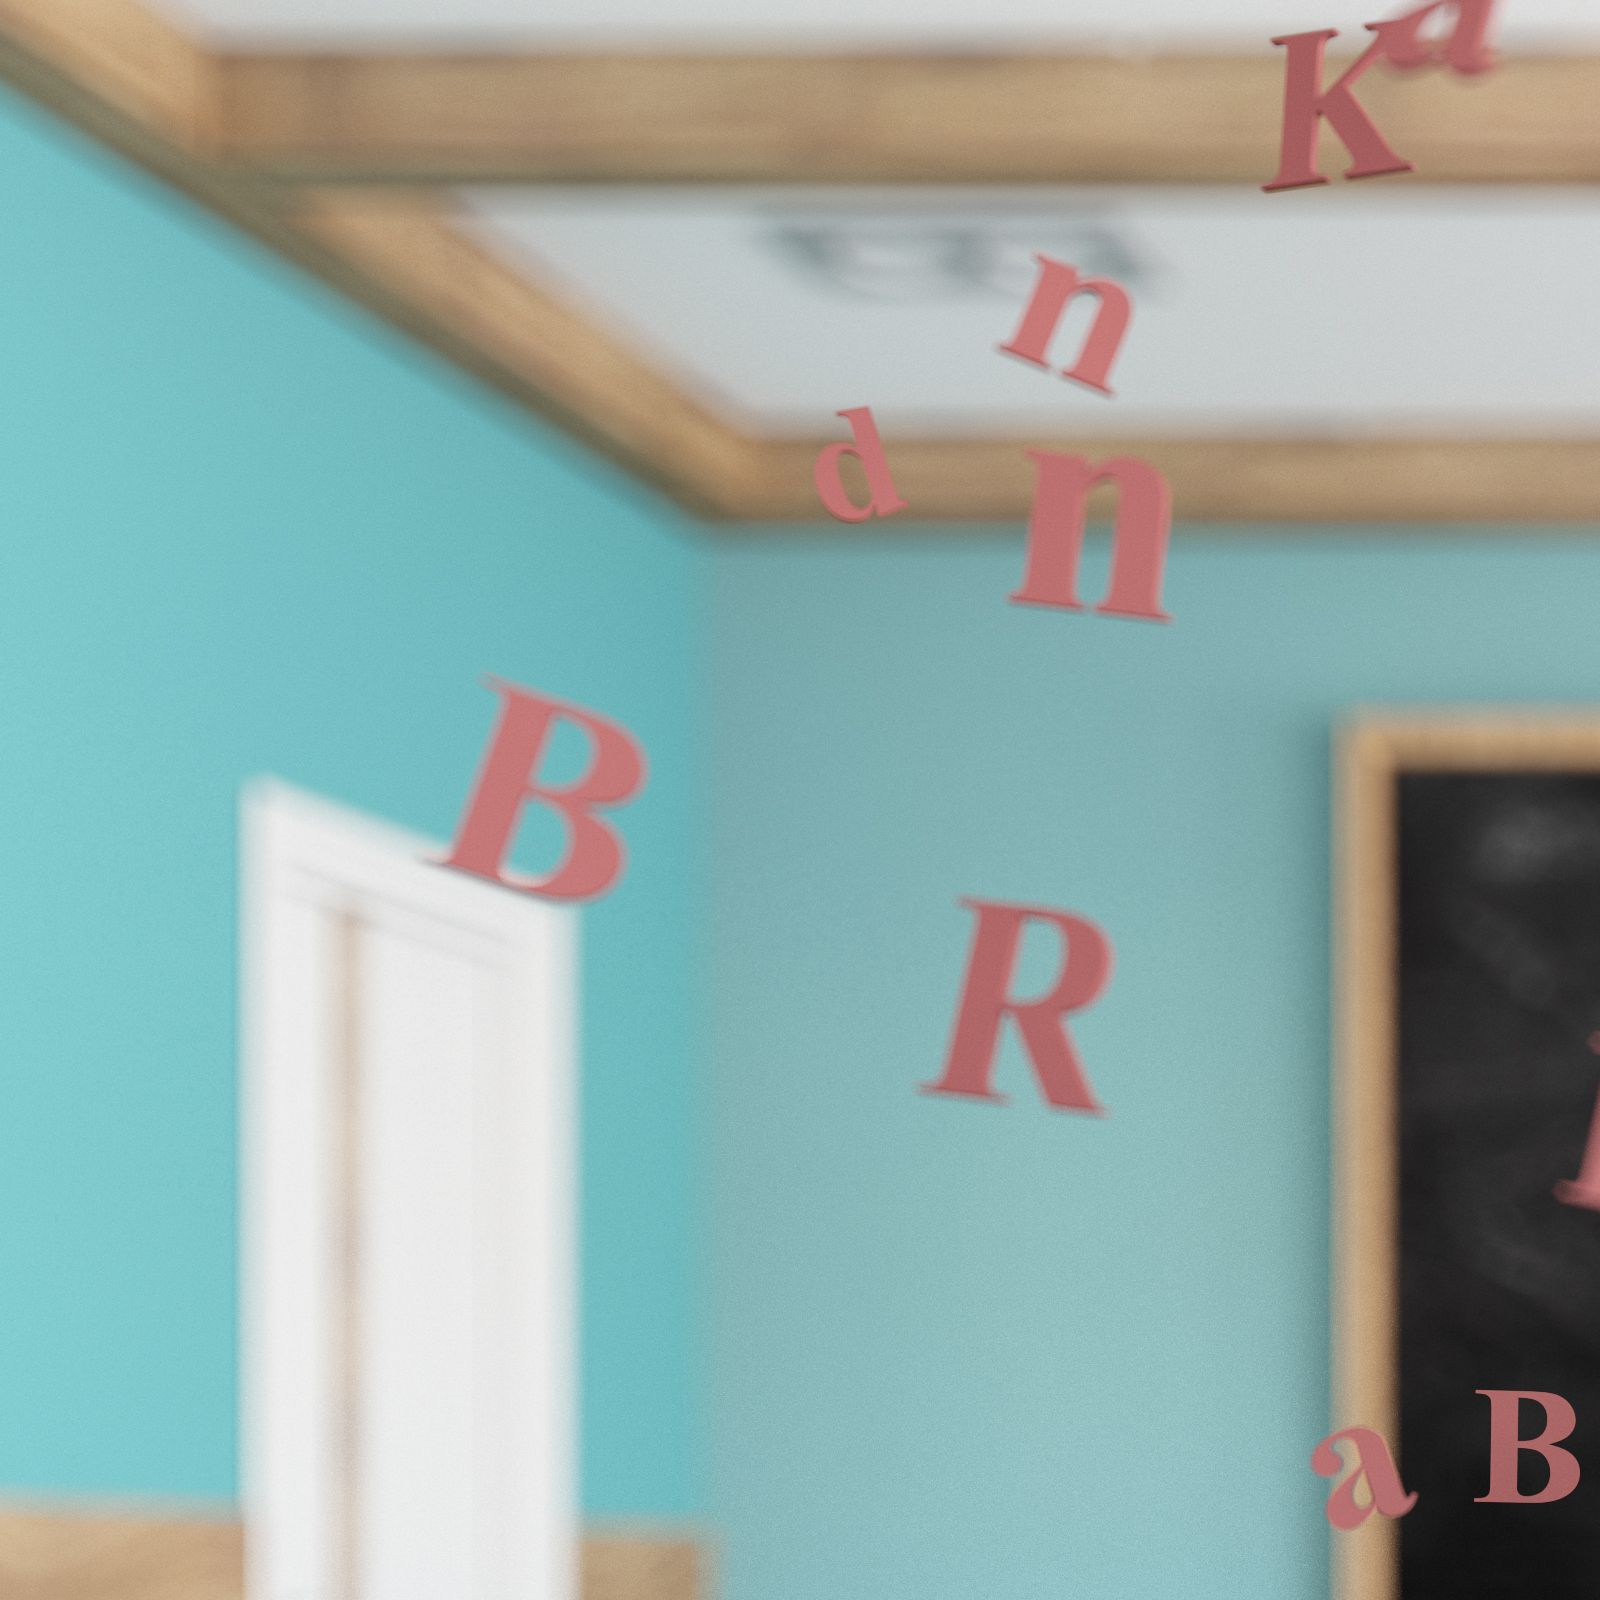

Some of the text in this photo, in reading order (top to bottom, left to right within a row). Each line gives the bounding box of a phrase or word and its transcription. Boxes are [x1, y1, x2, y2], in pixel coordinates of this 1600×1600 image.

[1260, 26, 1416, 193] K
[995, 256, 1134, 395] n
[812, 405, 910, 524] d
[1007, 448, 1174, 621] n
[424, 680, 648, 903] B
[924, 896, 1111, 1116] R
[1311, 1426, 1420, 1532] a
[1474, 1388, 1582, 1505] B
